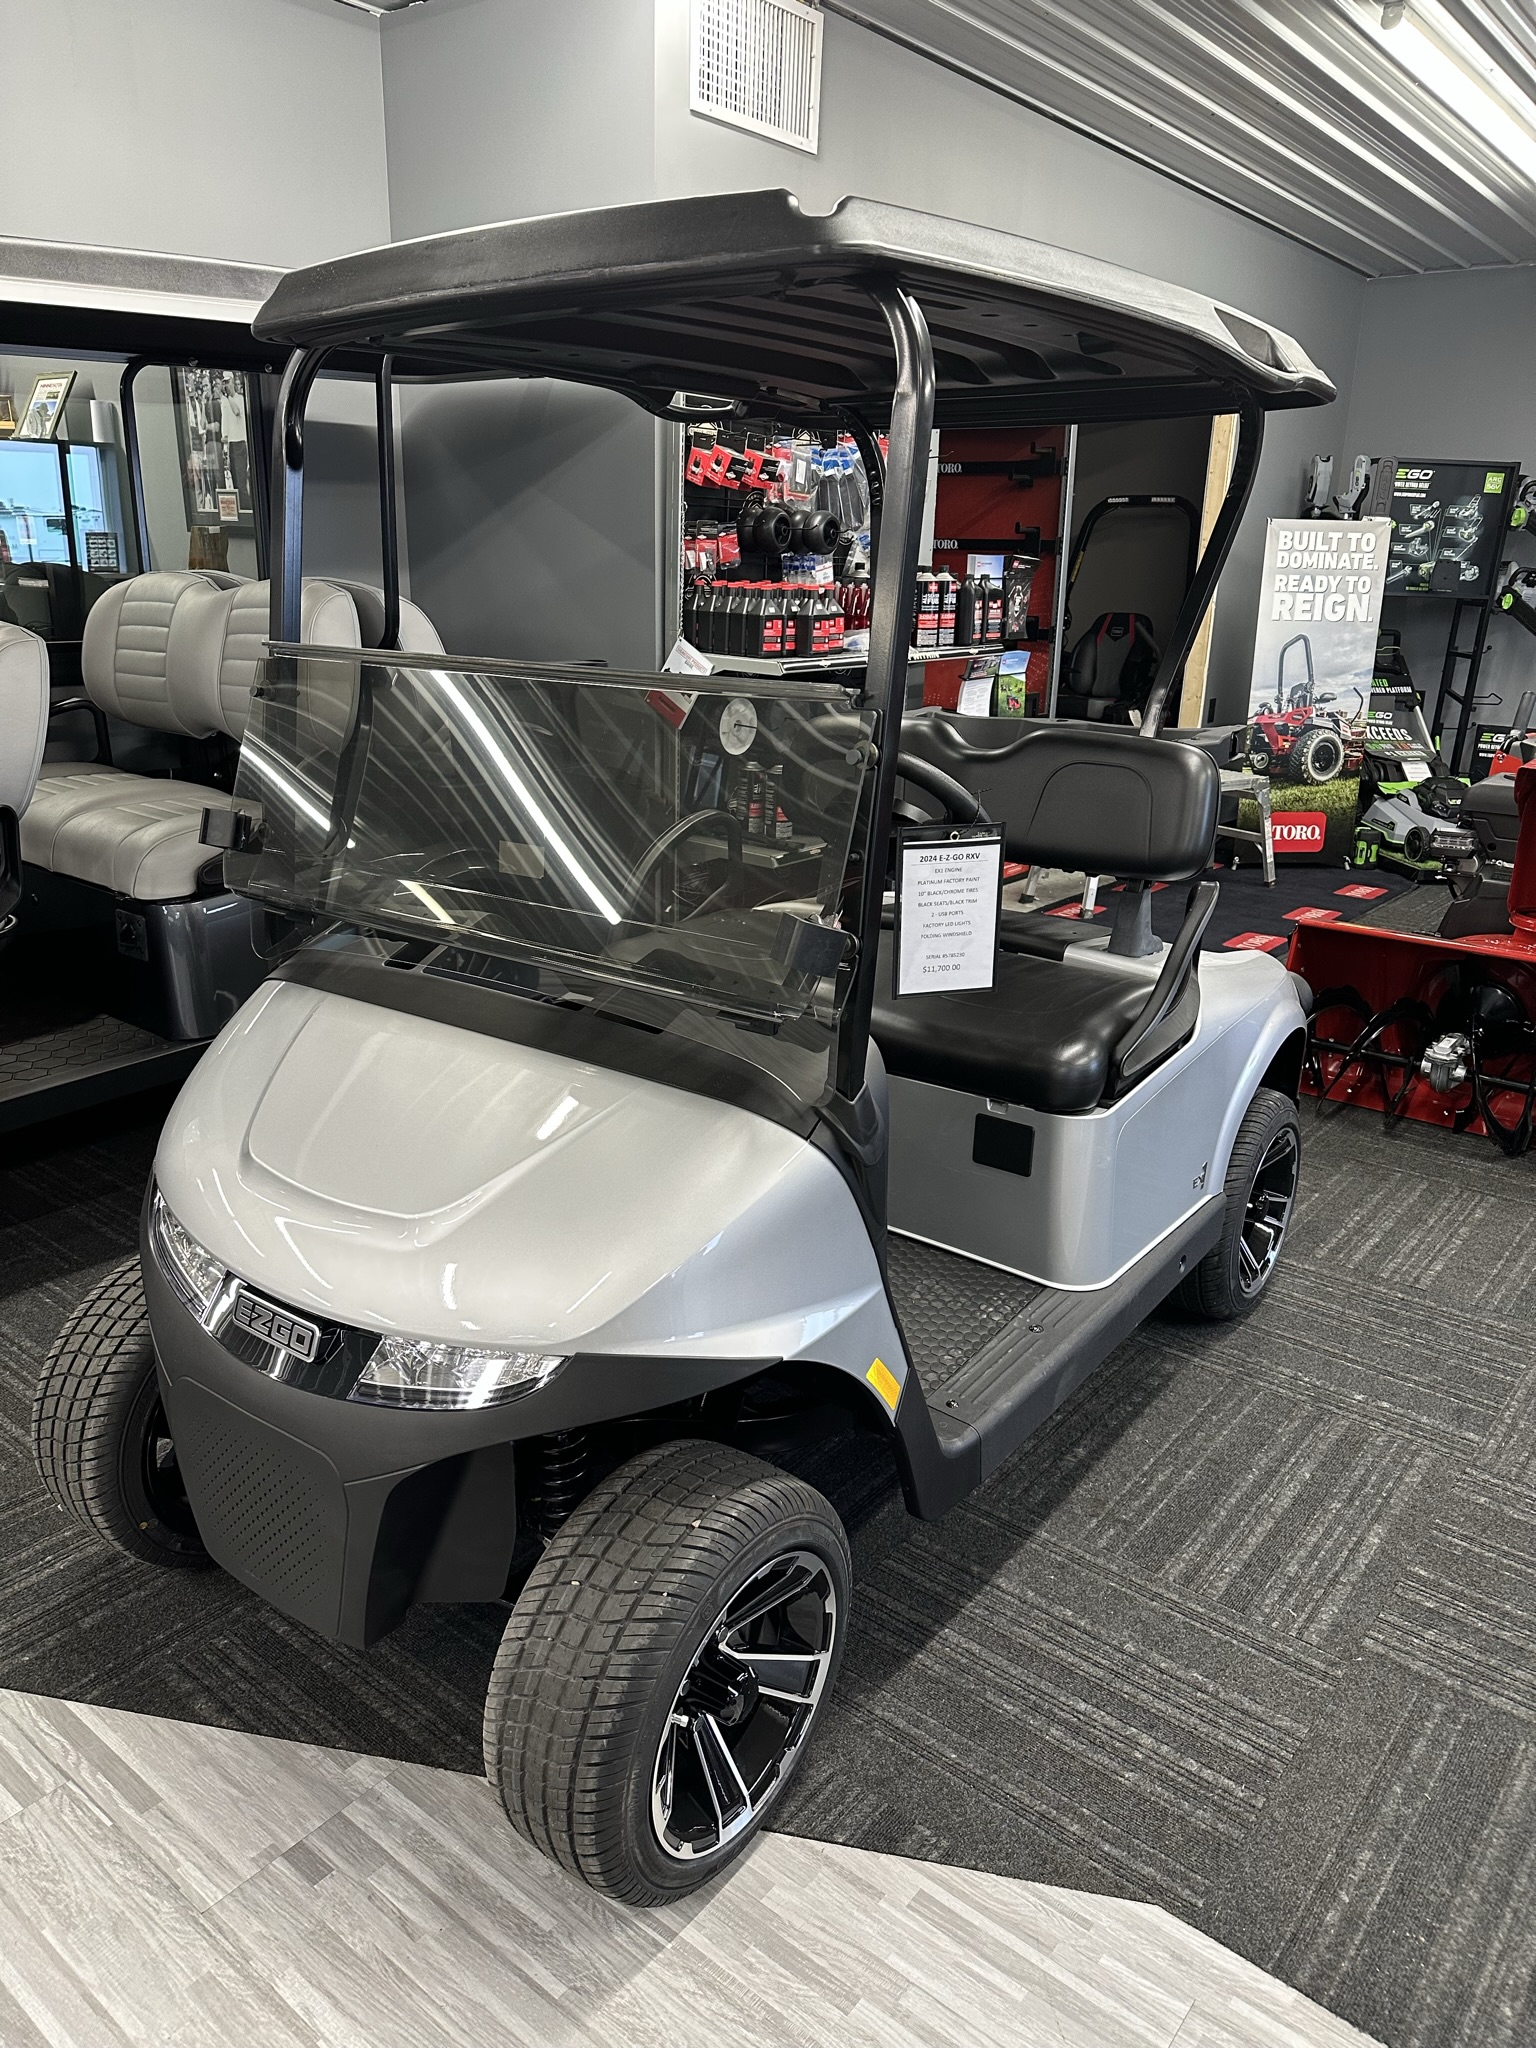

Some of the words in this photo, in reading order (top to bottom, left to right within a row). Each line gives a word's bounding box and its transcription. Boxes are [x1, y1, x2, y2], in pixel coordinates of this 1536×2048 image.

[1395, 468, 1434, 480] EGO
[1278, 530, 1343, 552] BUILT
[1348, 531, 1376, 553] TO
[1276, 551, 1379, 571] DOMINATE.
[1274, 574, 1344, 593] READY
[1345, 576, 1372, 594] TO
[1271, 593, 1374, 623] REIGN.
[1386, 686, 1412, 694] PLATFORM
[1366, 726, 1413, 742] XCEEDS
[1272, 824, 1321, 841] TORO
[919, 855, 937, 863] 2024
[939, 853, 964, 862] E-Z-GO
[965, 852, 981, 860] RXV
[917, 878, 943, 886] PLATINUM
[235, 1297, 313, 1355] EZGO
